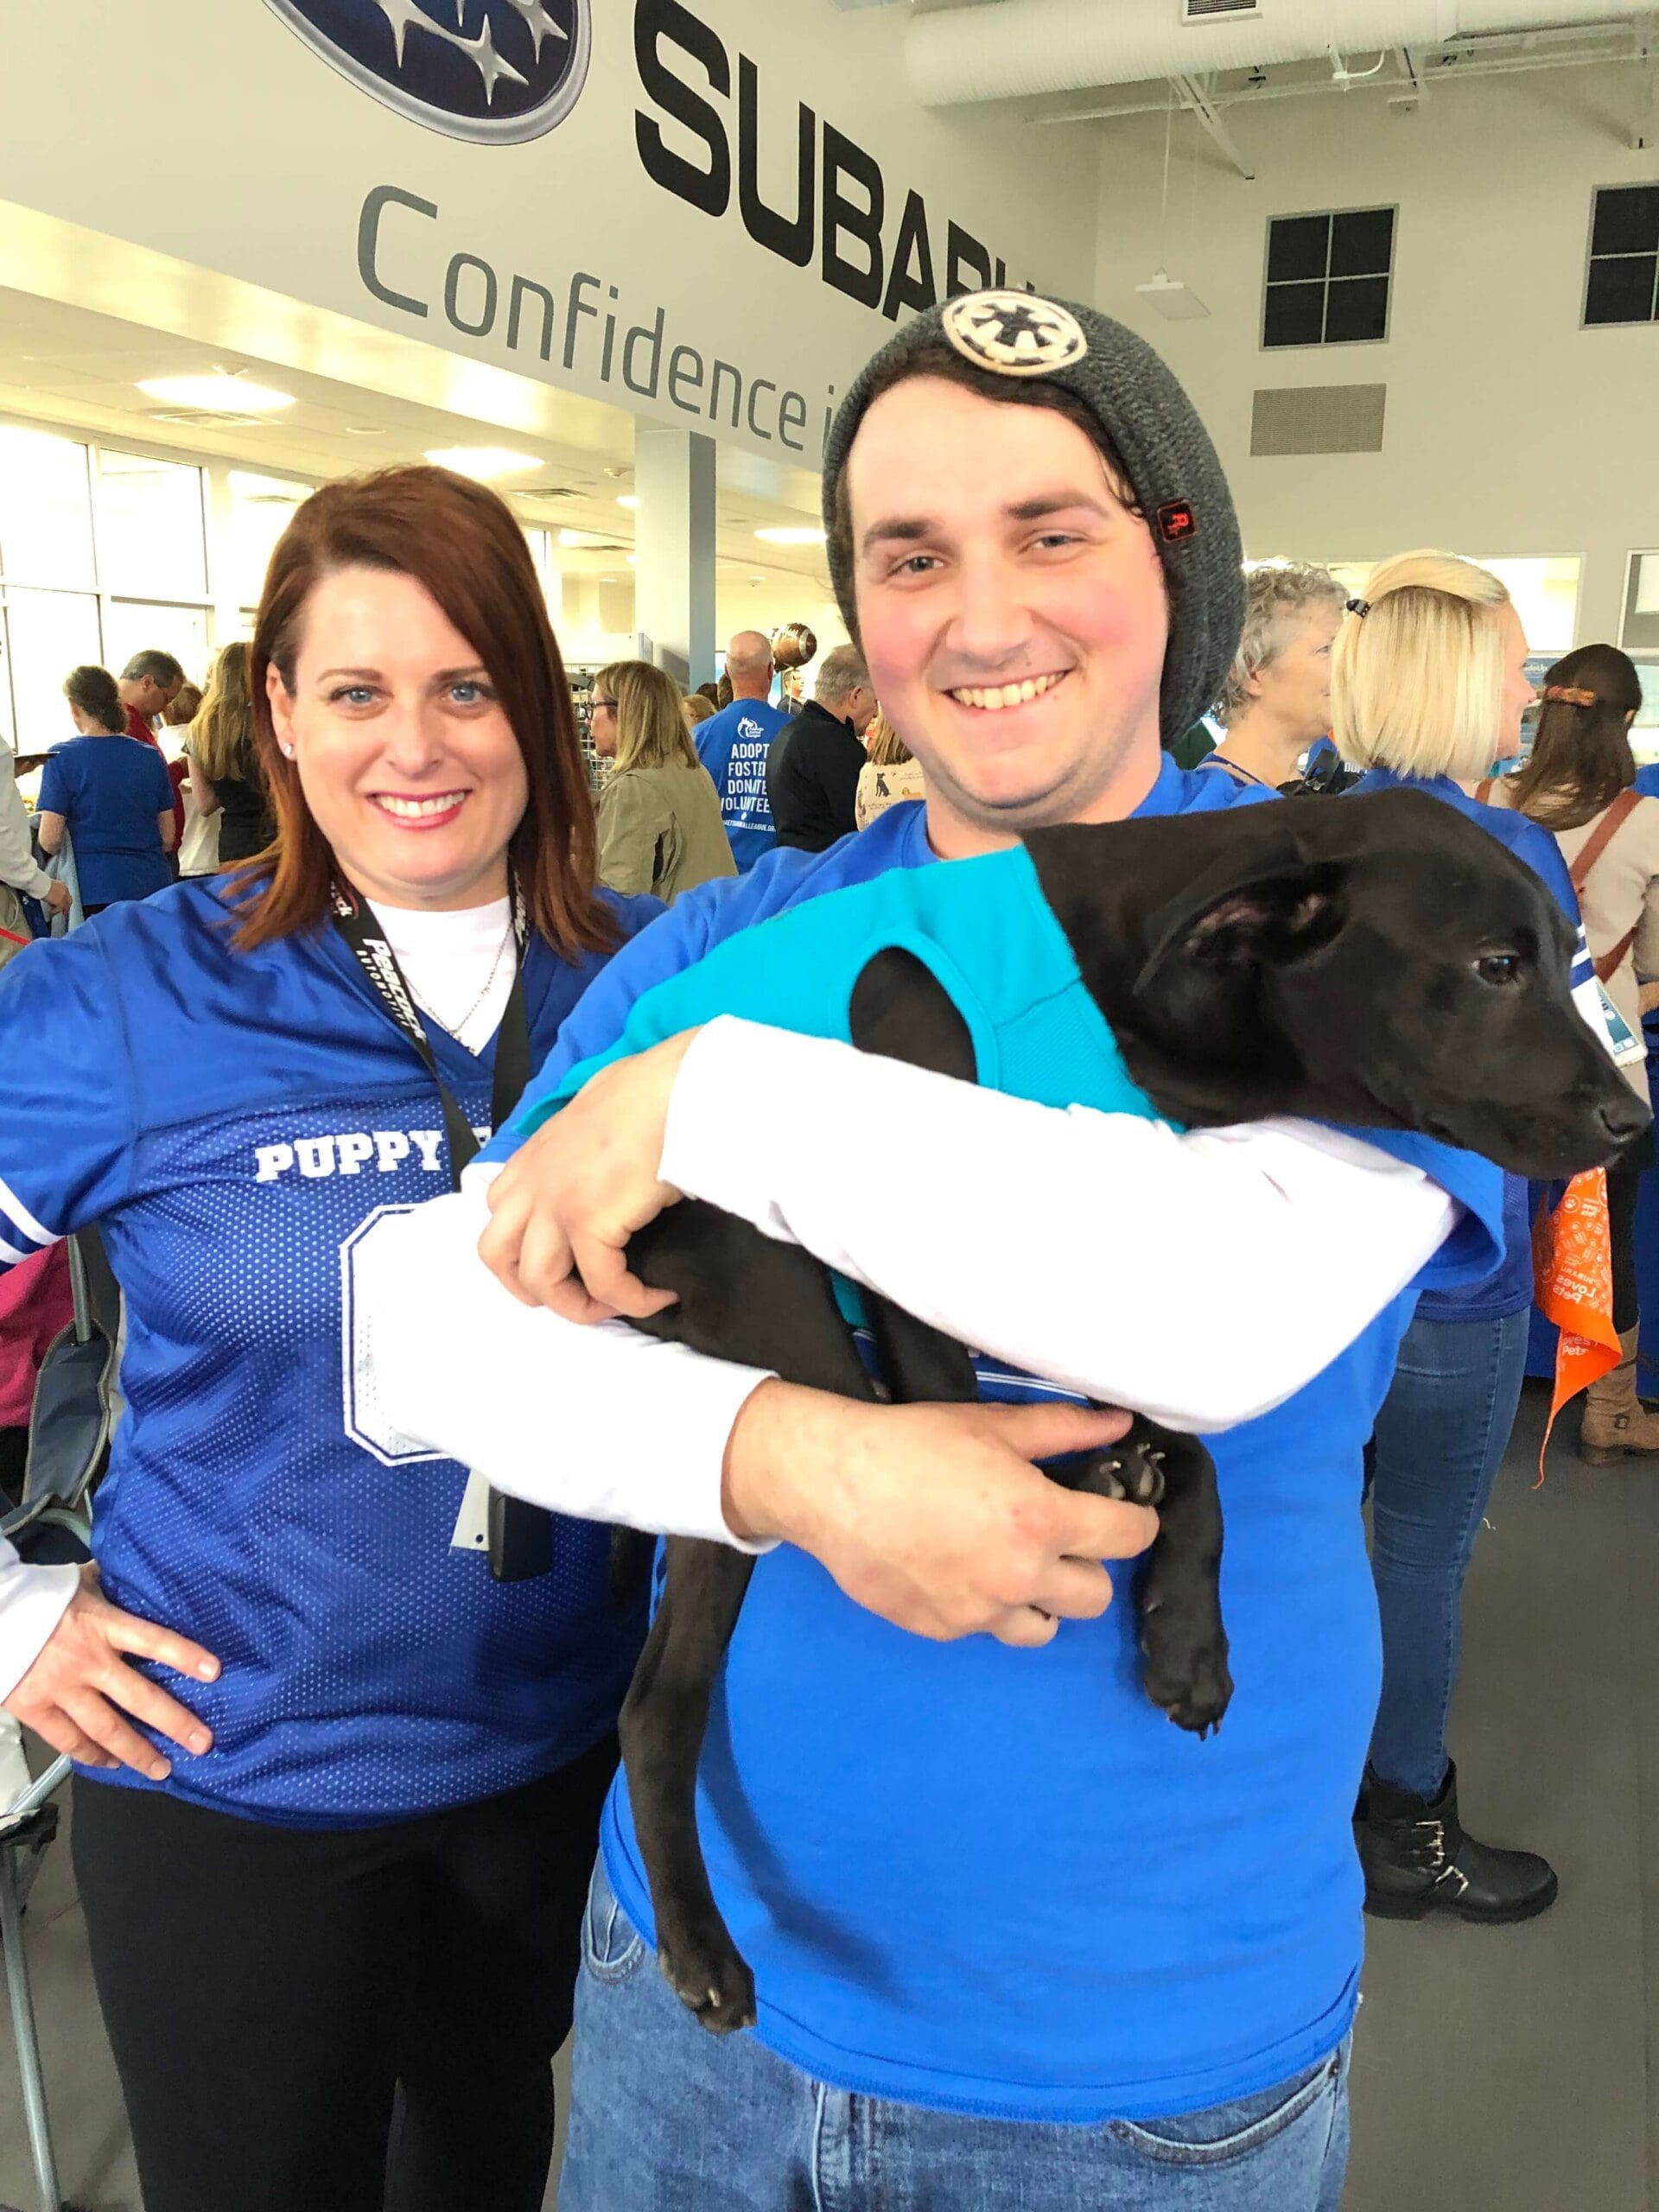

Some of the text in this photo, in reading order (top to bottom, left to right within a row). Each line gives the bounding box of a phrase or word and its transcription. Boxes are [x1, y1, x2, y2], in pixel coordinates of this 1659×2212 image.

[357, 185, 806, 451] Confidence
[731, 743, 769, 760] ADOPT
[255, 1130, 443, 1183] PUPPY
